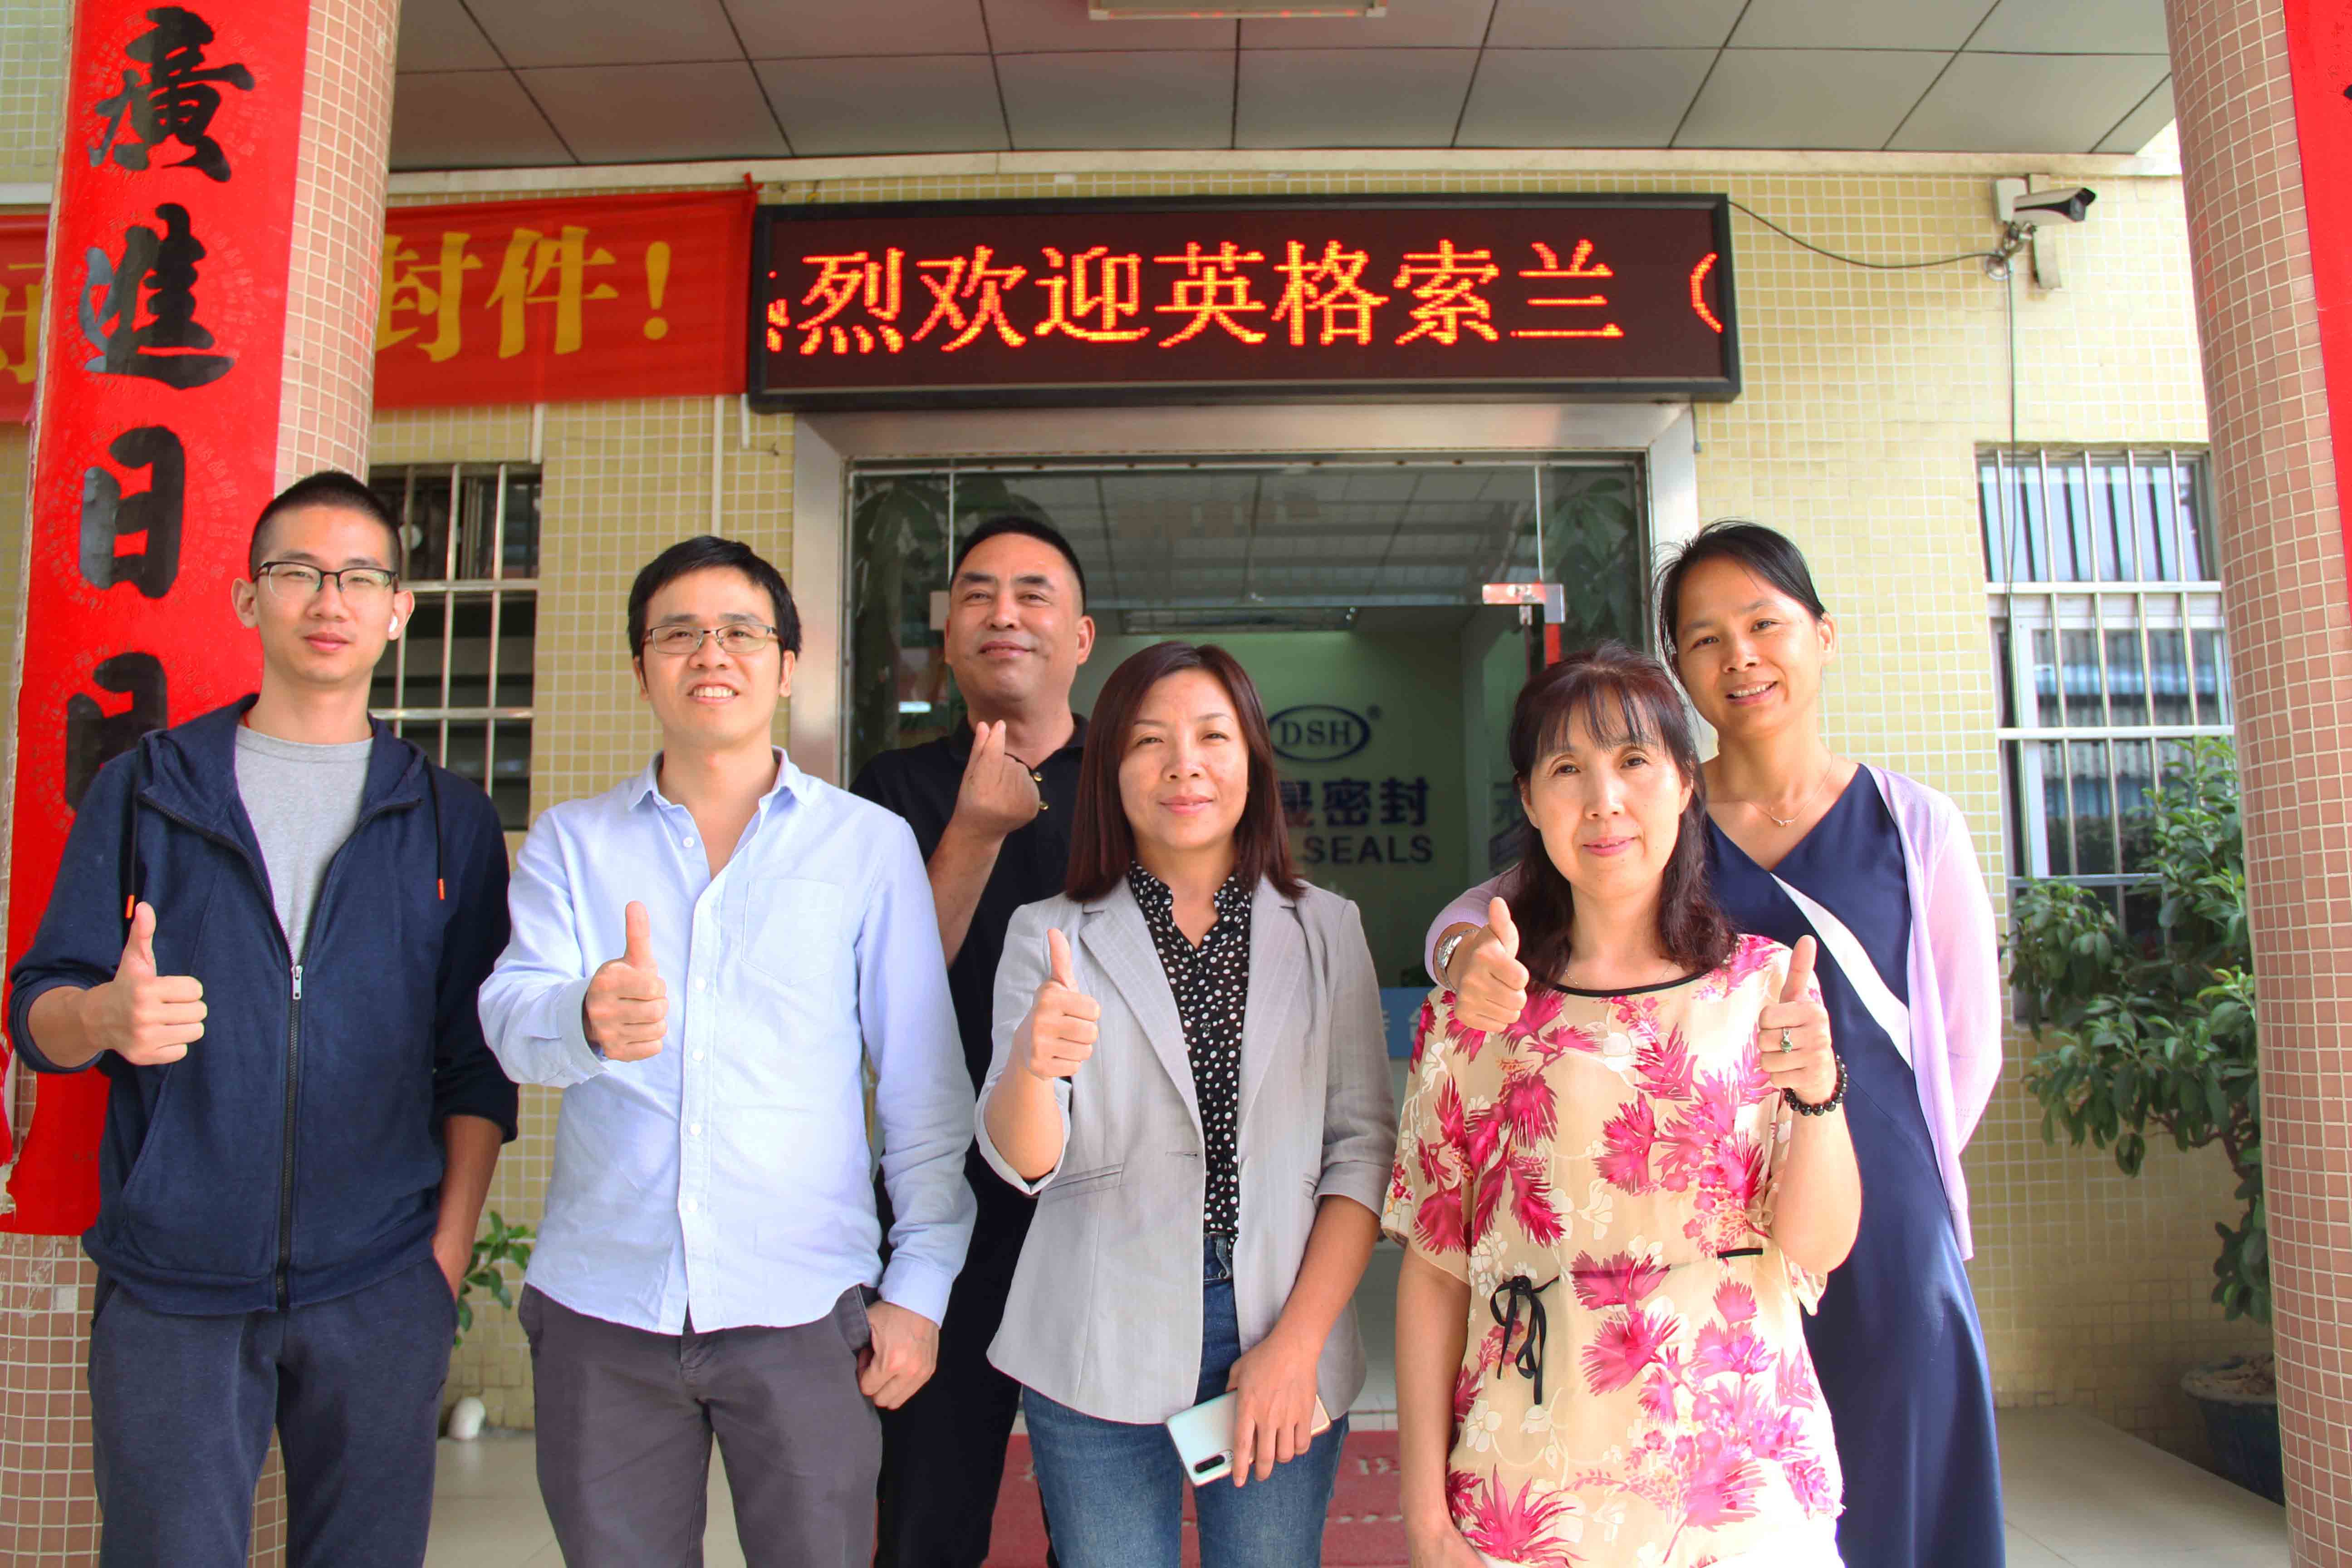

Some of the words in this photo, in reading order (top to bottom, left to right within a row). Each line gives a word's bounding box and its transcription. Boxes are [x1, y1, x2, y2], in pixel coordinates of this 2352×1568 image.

[767, 240, 1623, 354] 烈欢迎英格索兰
[1280, 719, 1352, 746] DSH
[1303, 835, 1433, 863] SEALS
